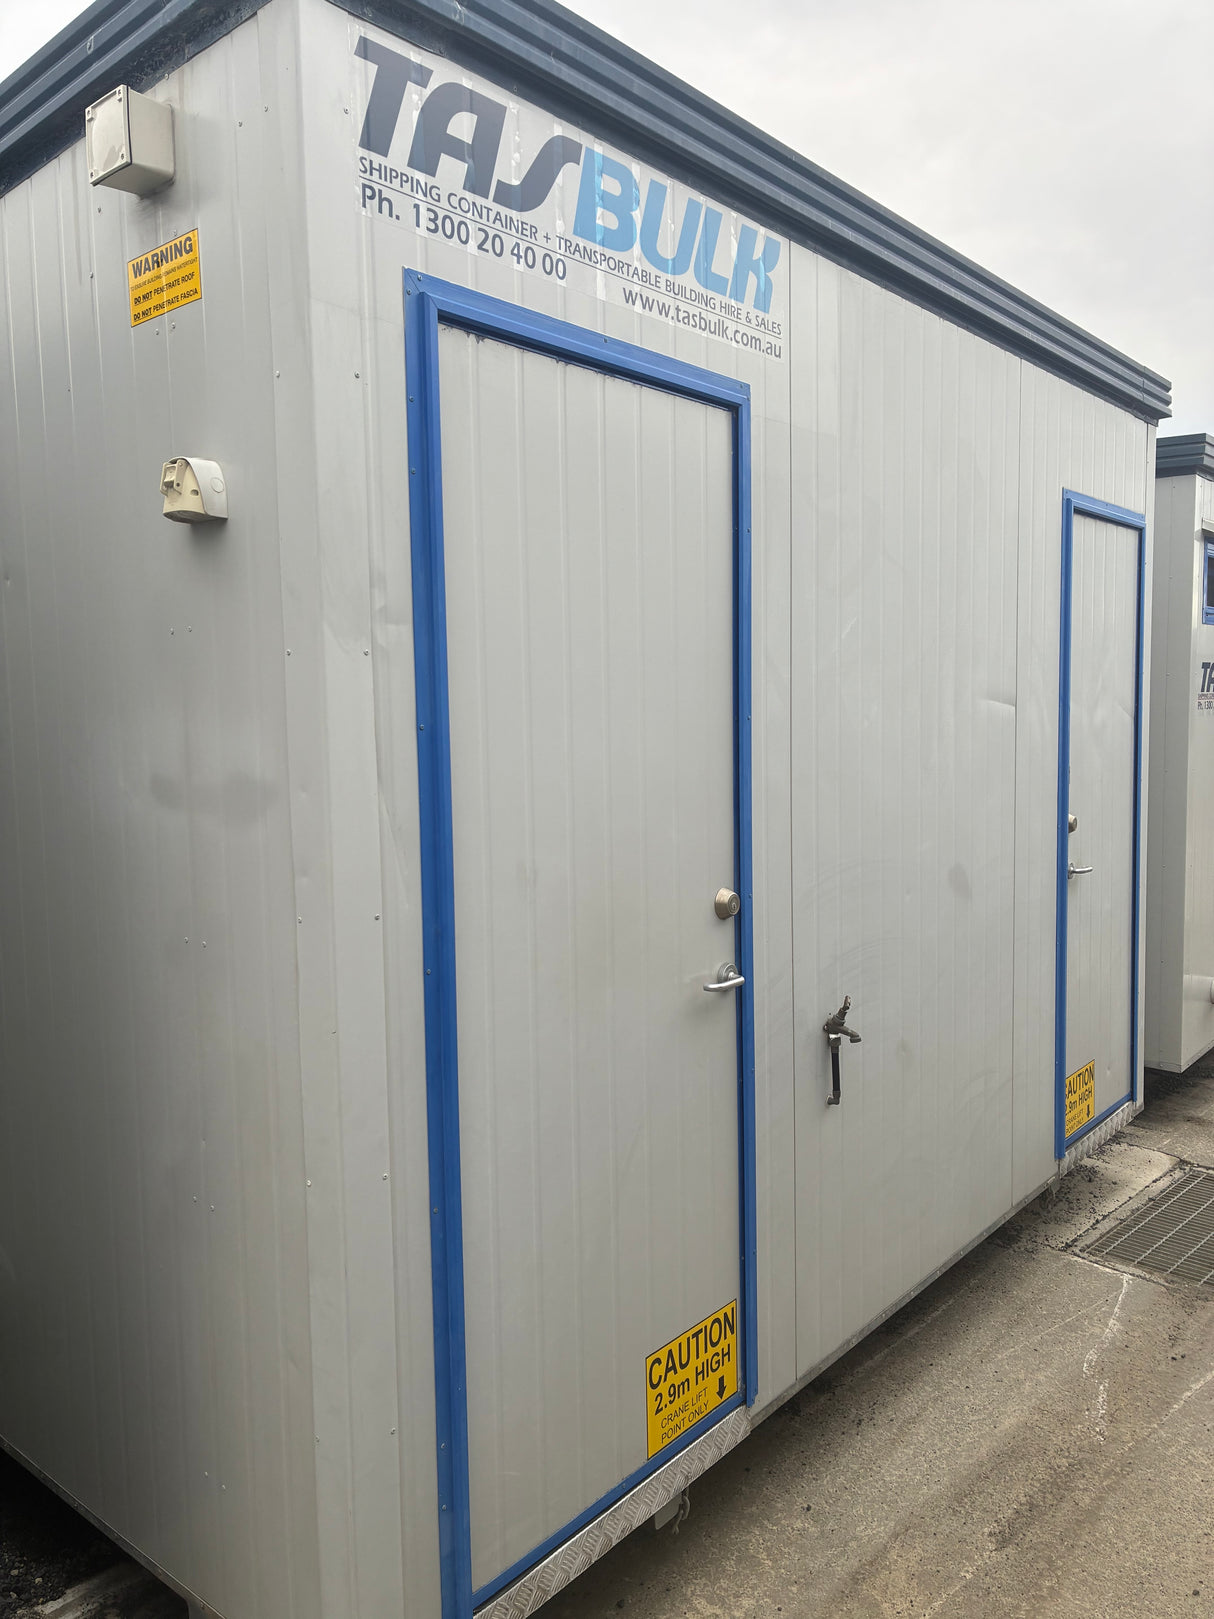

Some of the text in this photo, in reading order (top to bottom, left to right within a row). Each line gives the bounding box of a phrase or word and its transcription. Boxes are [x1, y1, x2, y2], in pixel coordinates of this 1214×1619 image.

[354, 36, 781, 314] TASBULK
[359, 156, 441, 203] SHIPPING
[447, 192, 538, 241] CONTAINER
[556, 235, 661, 289] TRANSPORTABLE
[665, 279, 716, 310] BUILDING
[720, 300, 742, 320] HIRE
[745, 311, 752, 323] &
[755, 315, 782, 335] SALES
[361, 182, 567, 280] Ph. 1300 20 40 00
[132, 236, 193, 279] WARNING
[133, 287, 198, 321] DO NOT PENETRATE FASCIA
[134, 271, 195, 305] DO NOT PENETRATE ROOF
[623, 287, 782, 358] www.tasbulk.com.au
[1066, 1063, 1094, 1099] AUTION
[1066, 1085, 1093, 1116] .9m HIGH
[649, 1307, 734, 1390] CAUTION
[654, 1344, 730, 1416] 2.9m HIGH
[660, 1387, 708, 1429] CRANE LIFT
[661, 1400, 709, 1444] POINT ONLY
